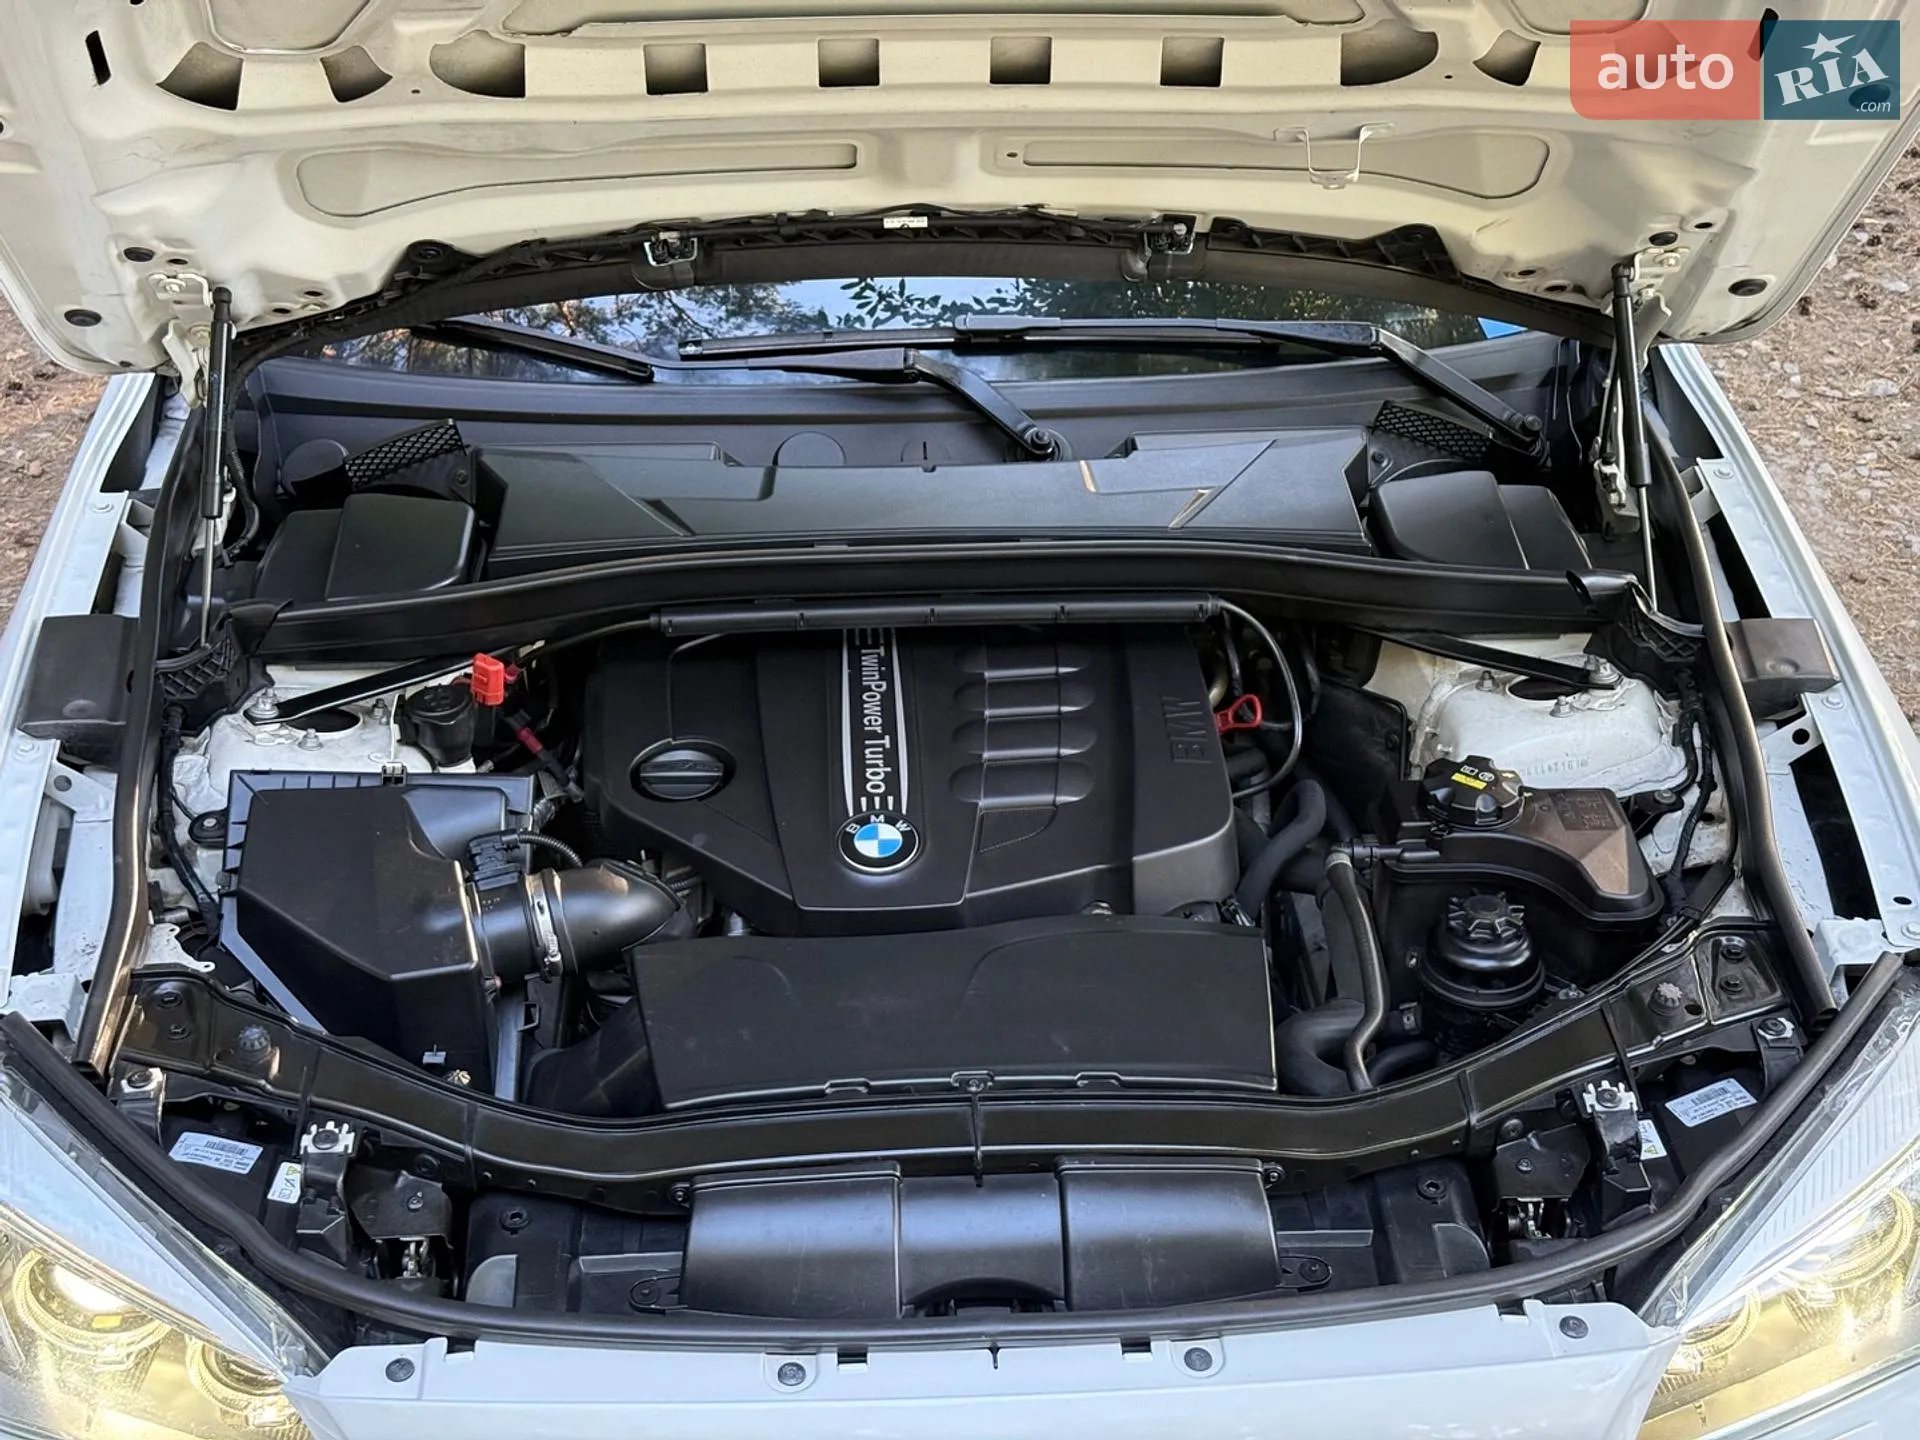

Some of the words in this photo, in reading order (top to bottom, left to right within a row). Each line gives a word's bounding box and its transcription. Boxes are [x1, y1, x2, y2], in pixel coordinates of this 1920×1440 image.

[860, 646, 887, 732] TwinPower
[1160, 694, 1213, 764] BMW
[864, 735, 891, 794] Turbo
